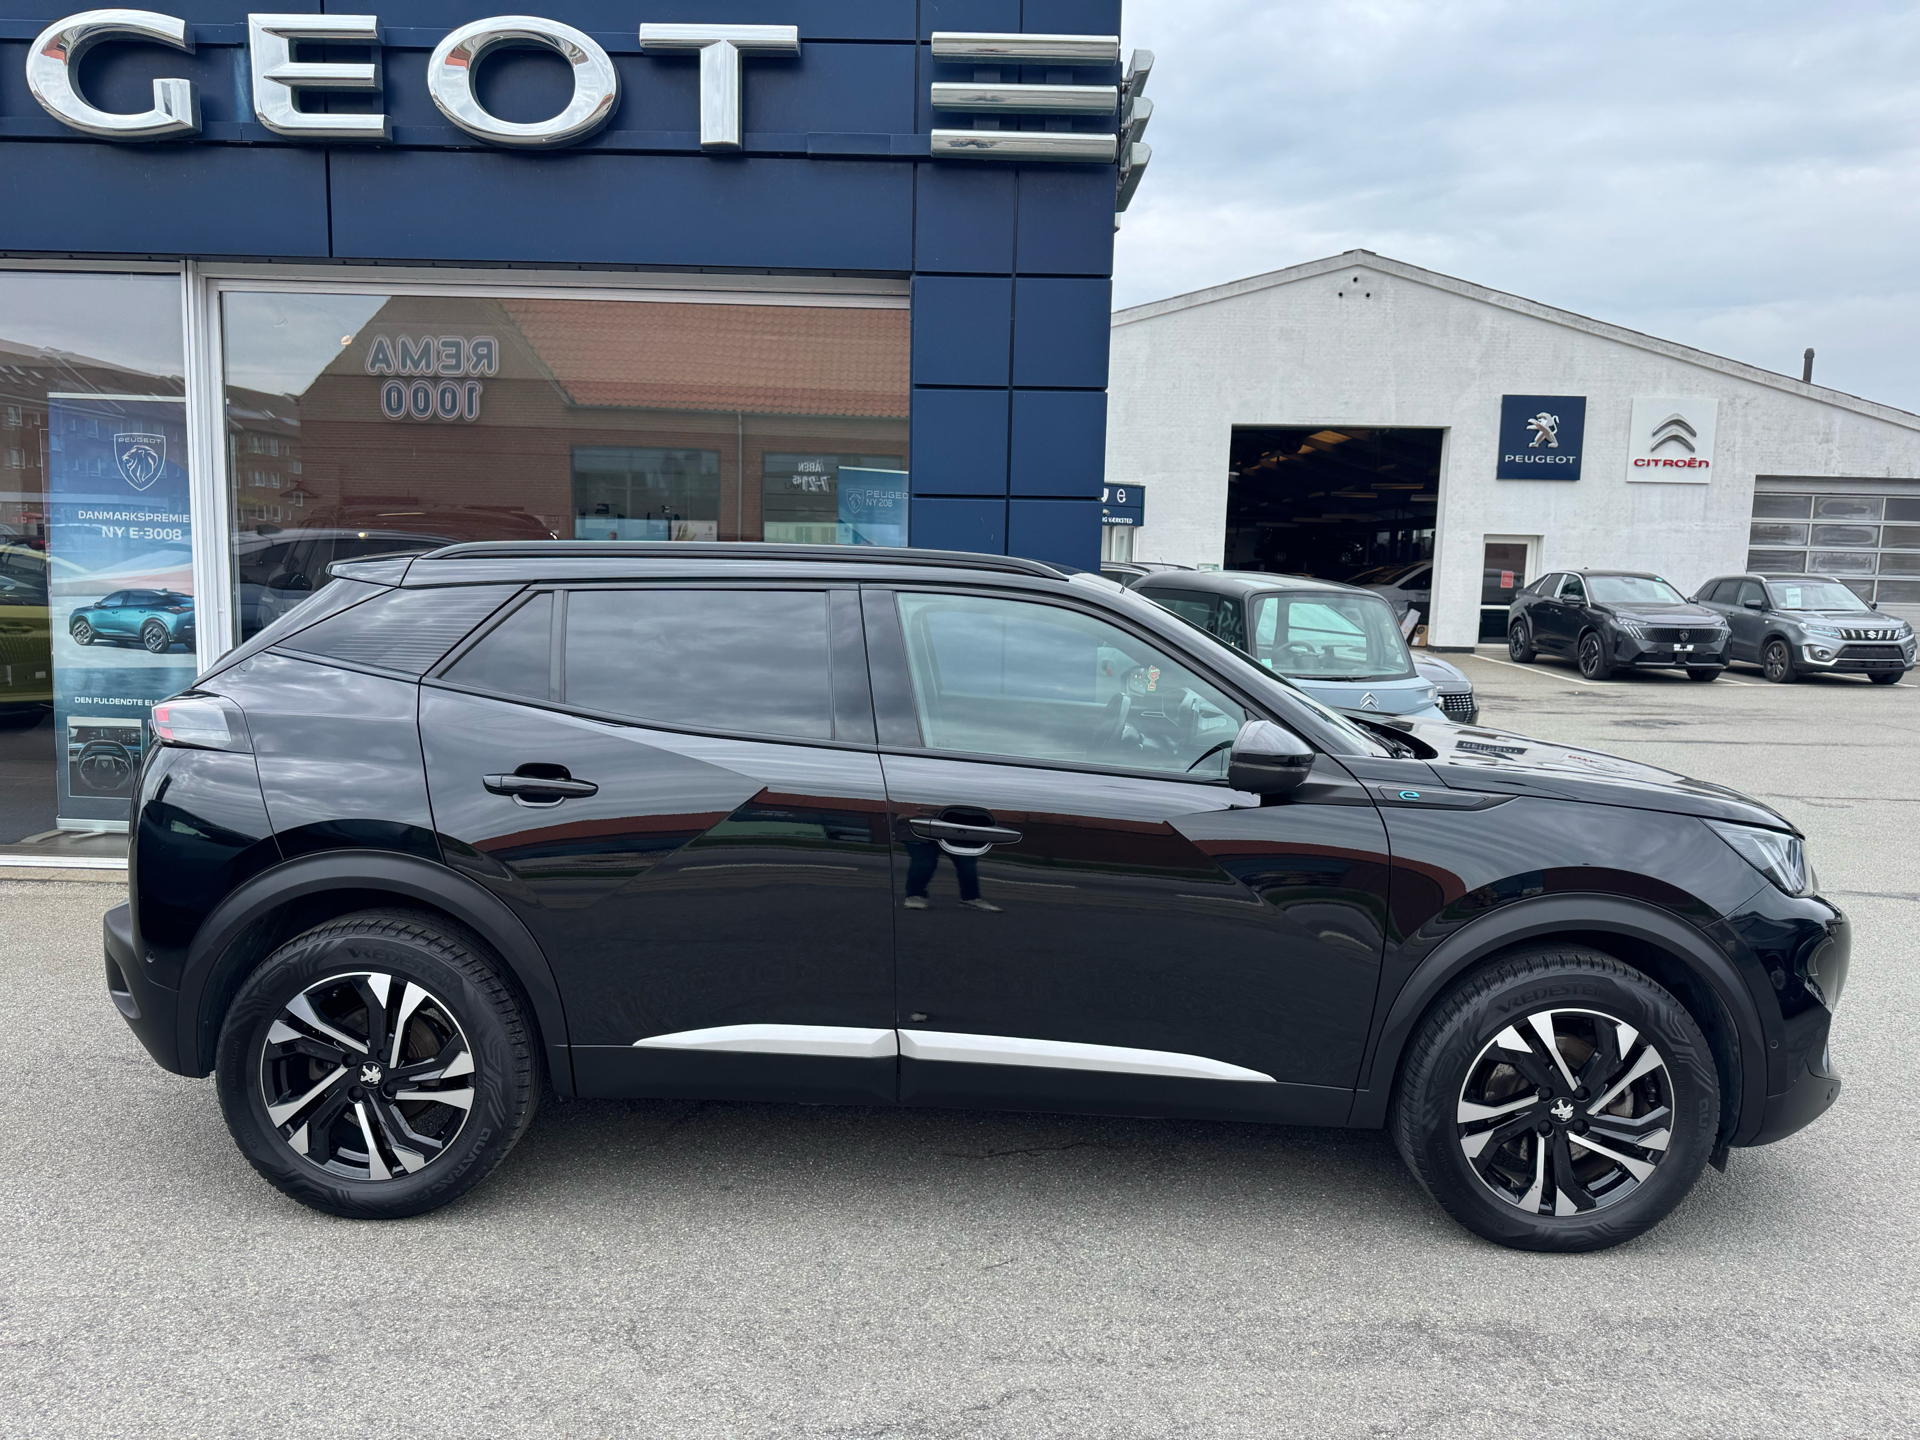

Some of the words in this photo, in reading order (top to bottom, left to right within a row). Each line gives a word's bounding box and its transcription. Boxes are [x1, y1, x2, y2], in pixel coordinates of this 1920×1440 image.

[26, 9, 800, 152] GEOT
[1504, 454, 1577, 464] PEUGEOT
[1633, 457, 1710, 469] CITROËN
[866, 498, 877, 506] NY
[879, 499, 893, 507] 208
[78, 510, 190, 523] DANMARKSPREMIE
[102, 526, 125, 538] NY
[129, 527, 182, 540] E-3008
[74, 696, 92, 704] DEN
[93, 697, 143, 706] FULDENDTE
[431, 1127, 493, 1193] QUATRAC
